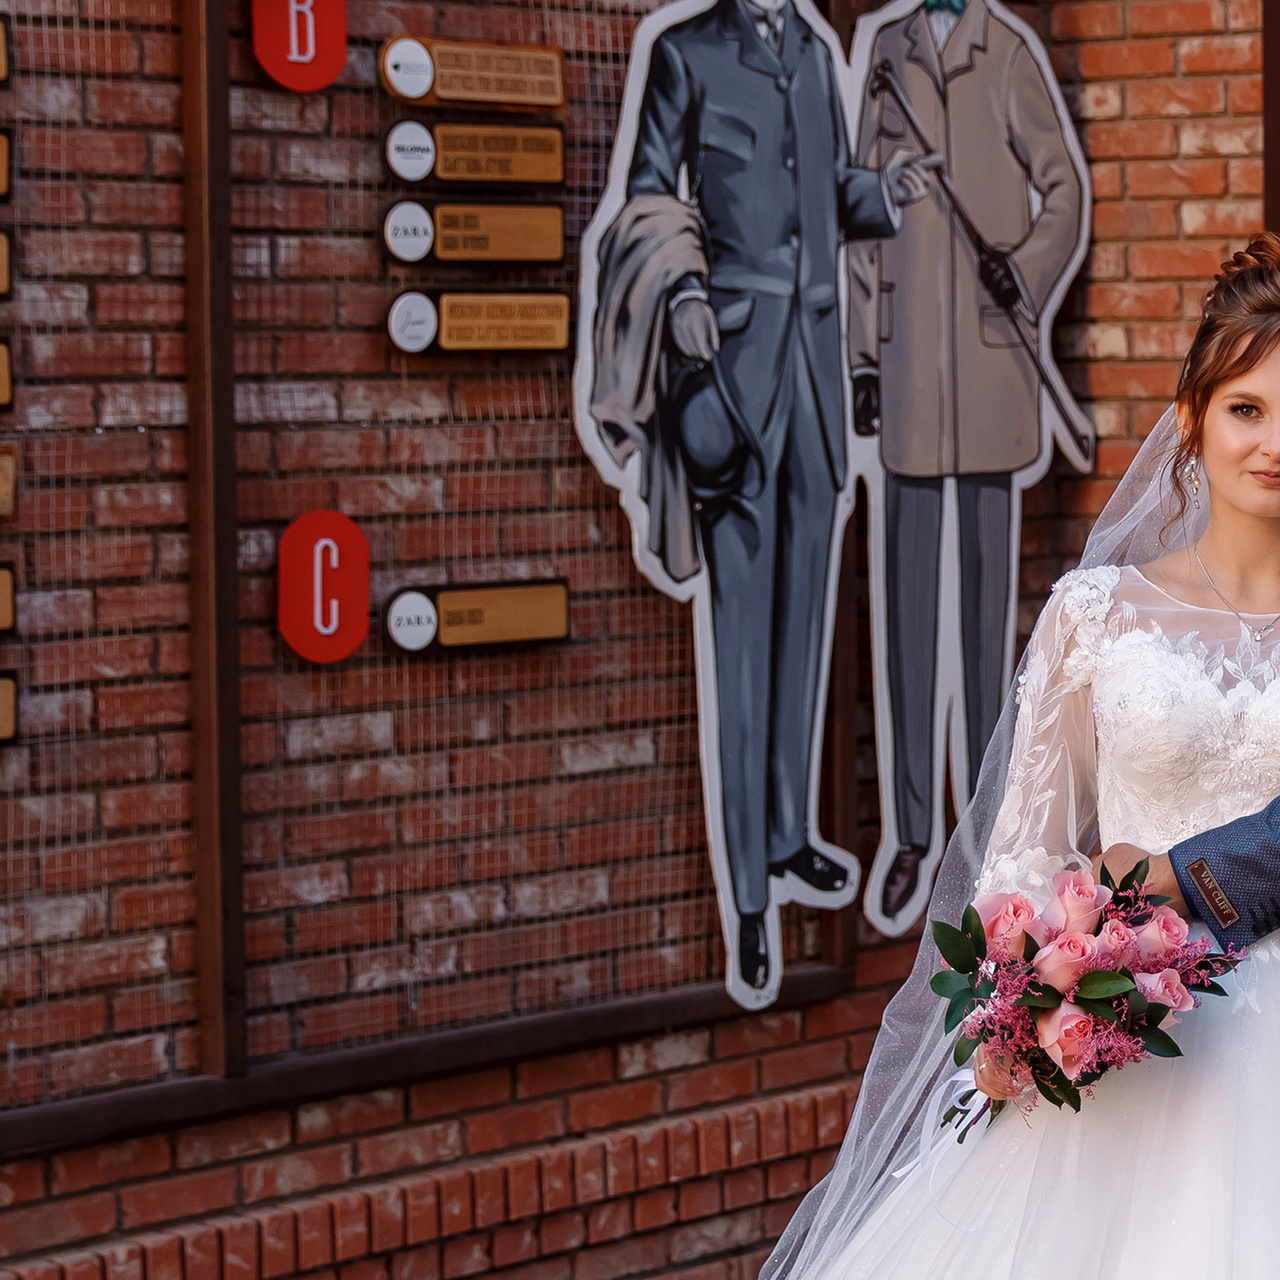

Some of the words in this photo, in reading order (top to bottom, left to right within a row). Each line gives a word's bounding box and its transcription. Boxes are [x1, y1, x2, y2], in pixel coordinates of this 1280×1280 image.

[391, 224, 430, 238] ZARA
[313, 537, 340, 636] C
[394, 614, 435, 628] ZARA
[1201, 870, 1215, 890] VAN
[1211, 890, 1232, 915] CLIFF
